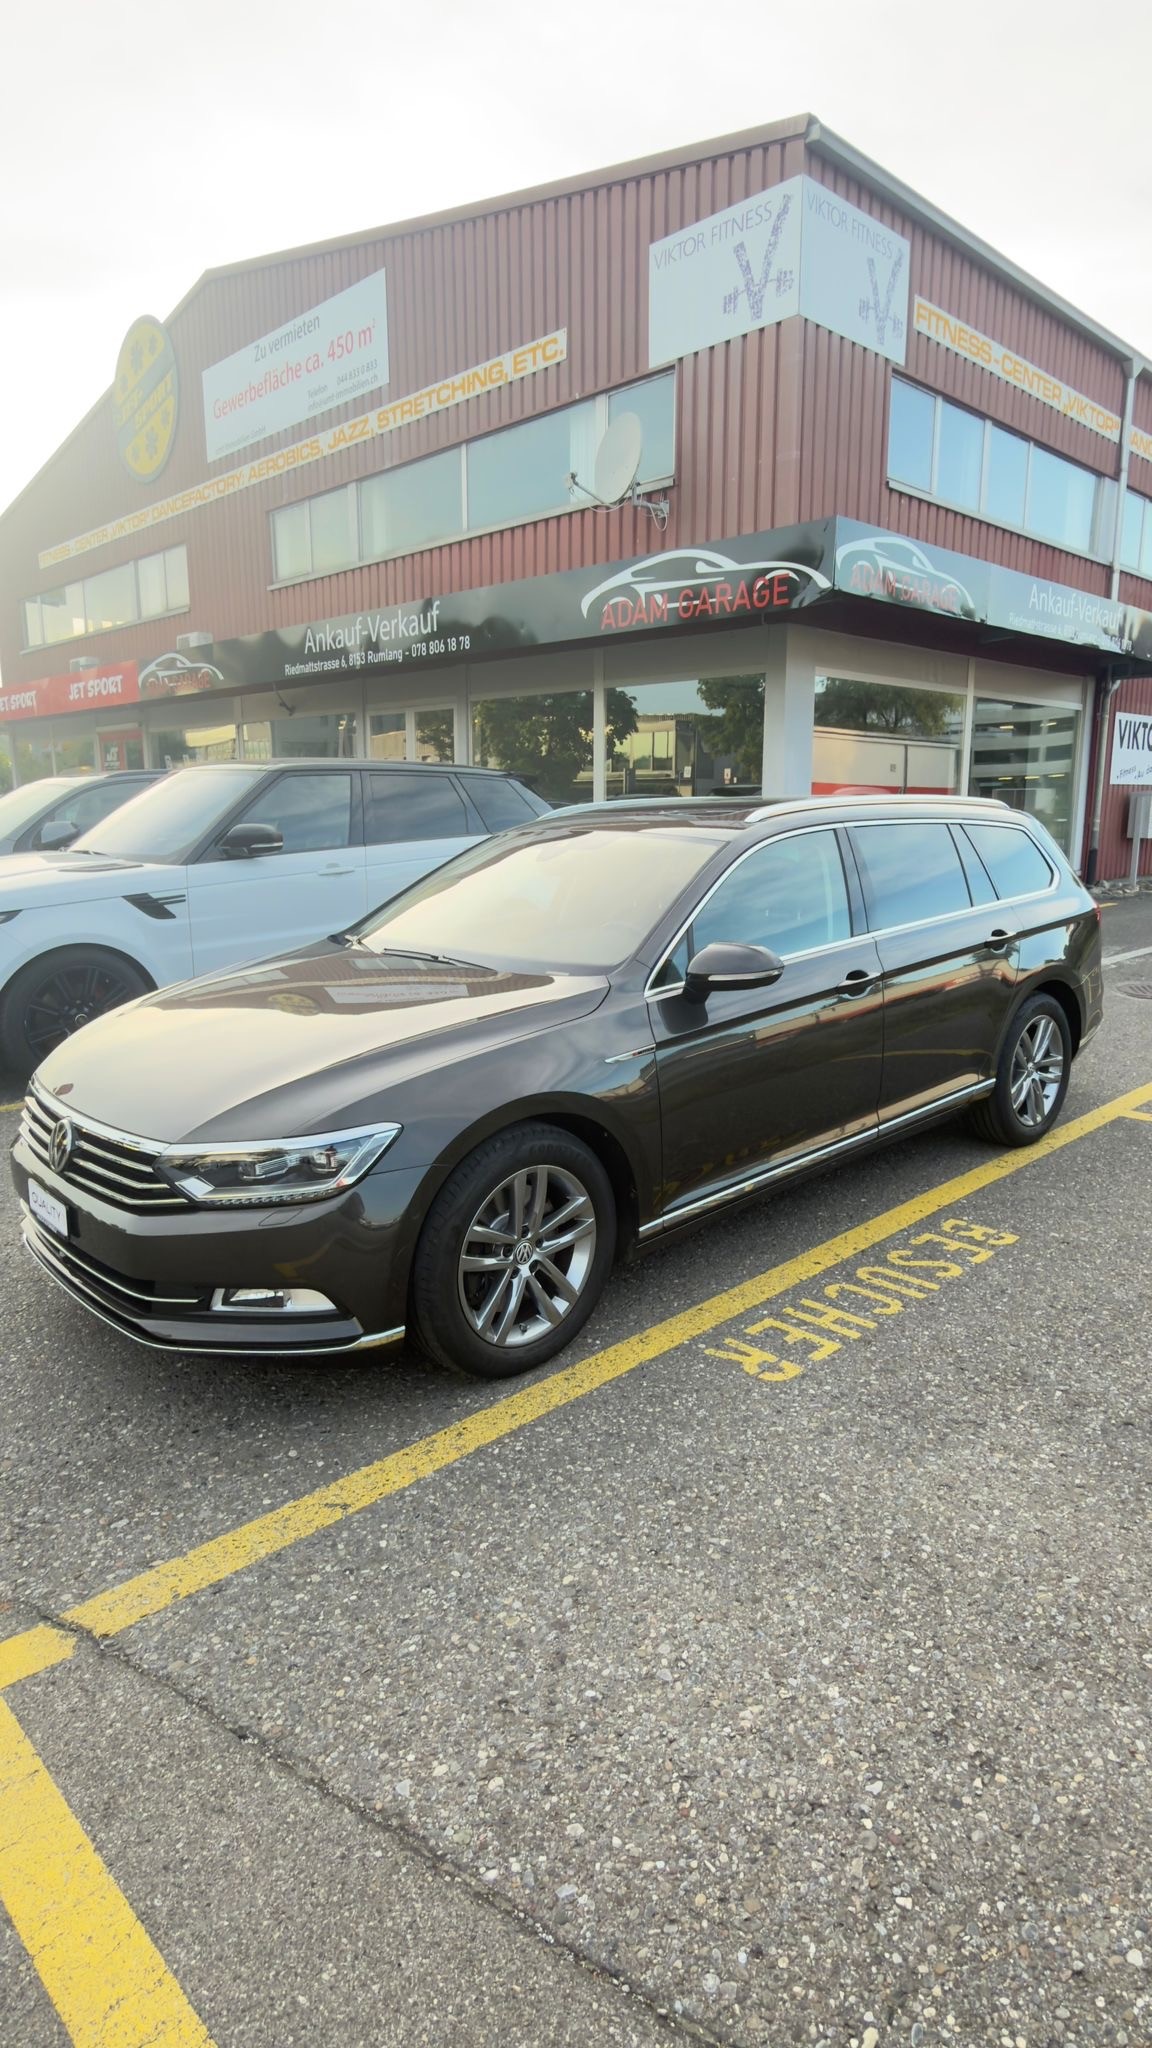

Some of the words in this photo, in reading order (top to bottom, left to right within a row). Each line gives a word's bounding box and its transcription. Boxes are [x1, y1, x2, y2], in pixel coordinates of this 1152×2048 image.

[653, 232, 706, 270] VIKTOR
[711, 200, 773, 245] FITNESS
[806, 191, 849, 232] VIKTOR
[852, 218, 893, 260] FITNESS
[254, 343, 267, 363] Zu
[269, 315, 321, 355] vermieten
[213, 361, 302, 420] Gewerbefläche
[305, 353, 324, 374] ca.
[327, 330, 354, 362] 450
[248, 438, 323, 480] AEROBICS,
[327, 416, 375, 450] JAZZ,
[376, 360, 509, 430] STRETCHING,
[512, 337, 564, 375] ETC.
[601, 593, 669, 631] ADAM
[678, 573, 791, 619] GARAGE
[849, 563, 896, 597] ADAM
[900, 575, 957, 611] GARAGE
[1028, 583, 1124, 632] Ankauf-Verkauf
[304, 600, 440, 654] Ankauf-Verkauf
[284, 657, 340, 677] Riedmattstrasse
[341, 656, 348, 669] 6,
[348, 652, 366, 667] 8153
[367, 648, 403, 664] Rumlang
[411, 644, 427, 658] 078
[428, 641, 445, 656] 806
[446, 637, 458, 652] 18
[458, 635, 471, 650] 78
[0, 695, 9, 712] ET
[10, 689, 37, 711] SPORT
[68, 680, 86, 701] JET
[87, 674, 123, 699] SPORT
[31, 1191, 63, 1221] QUALITY
[703, 1218, 1020, 1382] BESUCHER
